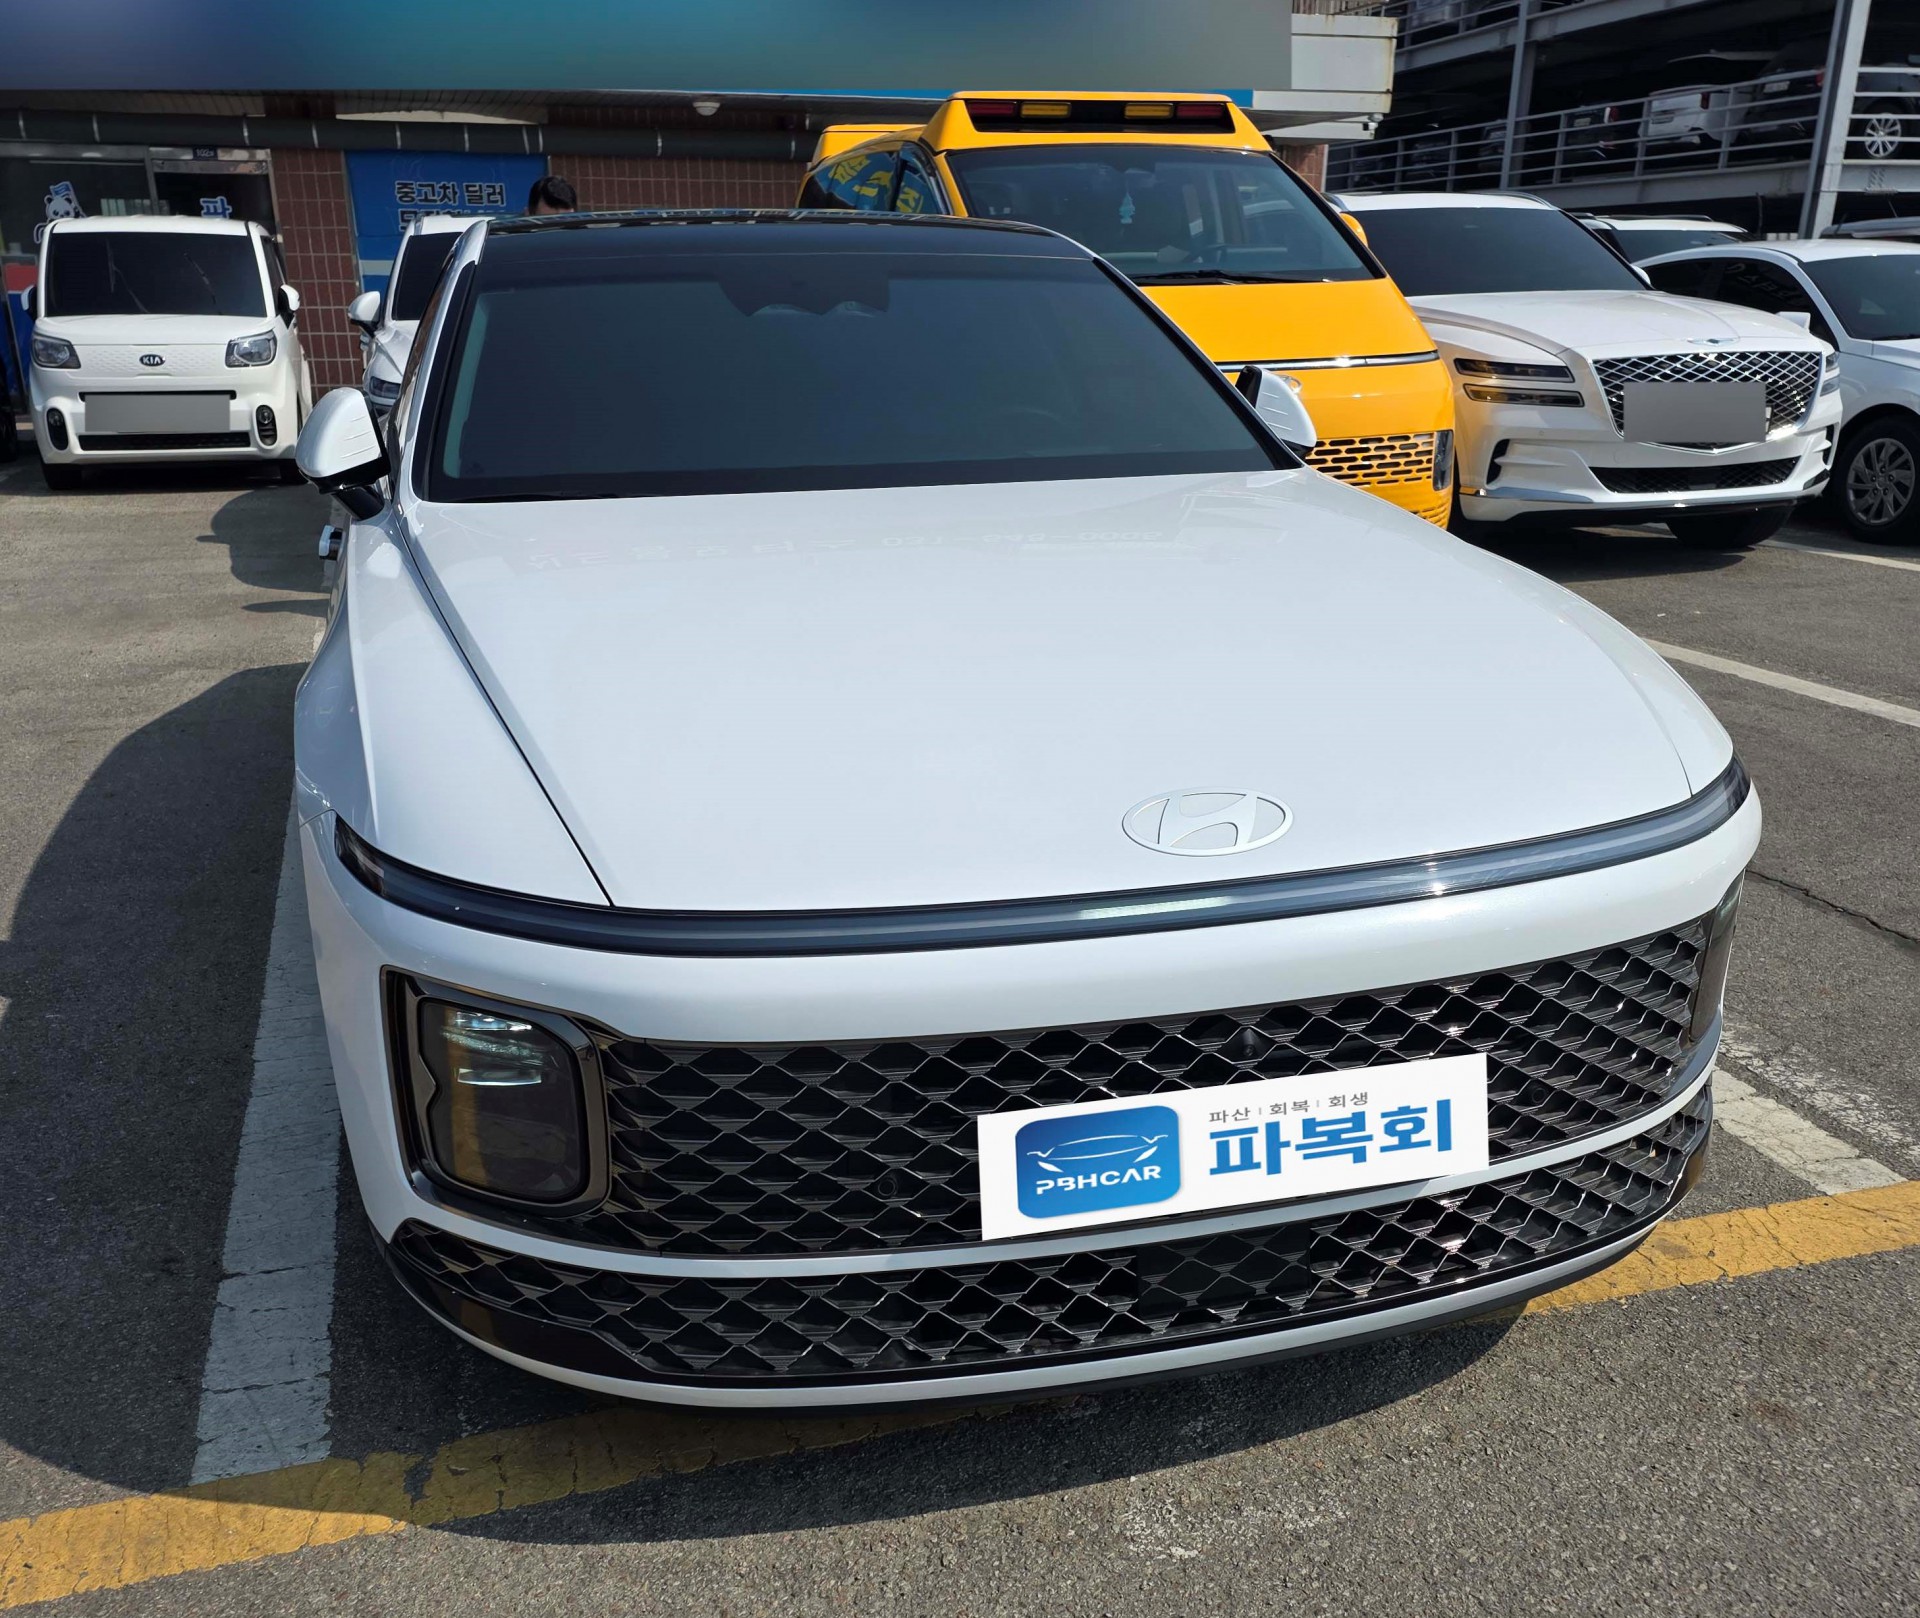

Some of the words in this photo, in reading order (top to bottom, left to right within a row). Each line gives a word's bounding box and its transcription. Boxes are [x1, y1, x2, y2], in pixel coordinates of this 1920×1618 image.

[395, 181, 458, 205] 중고차
[463, 183, 506, 206] 딜러
[142, 355, 161, 365] KIA
[1209, 1106, 1250, 1123] 파산
[1269, 1099, 1310, 1116] 회복
[1328, 1091, 1368, 1108] 회생
[1208, 1099, 1453, 1176] 파복회
[1036, 1165, 1162, 1195] PBHCAR
